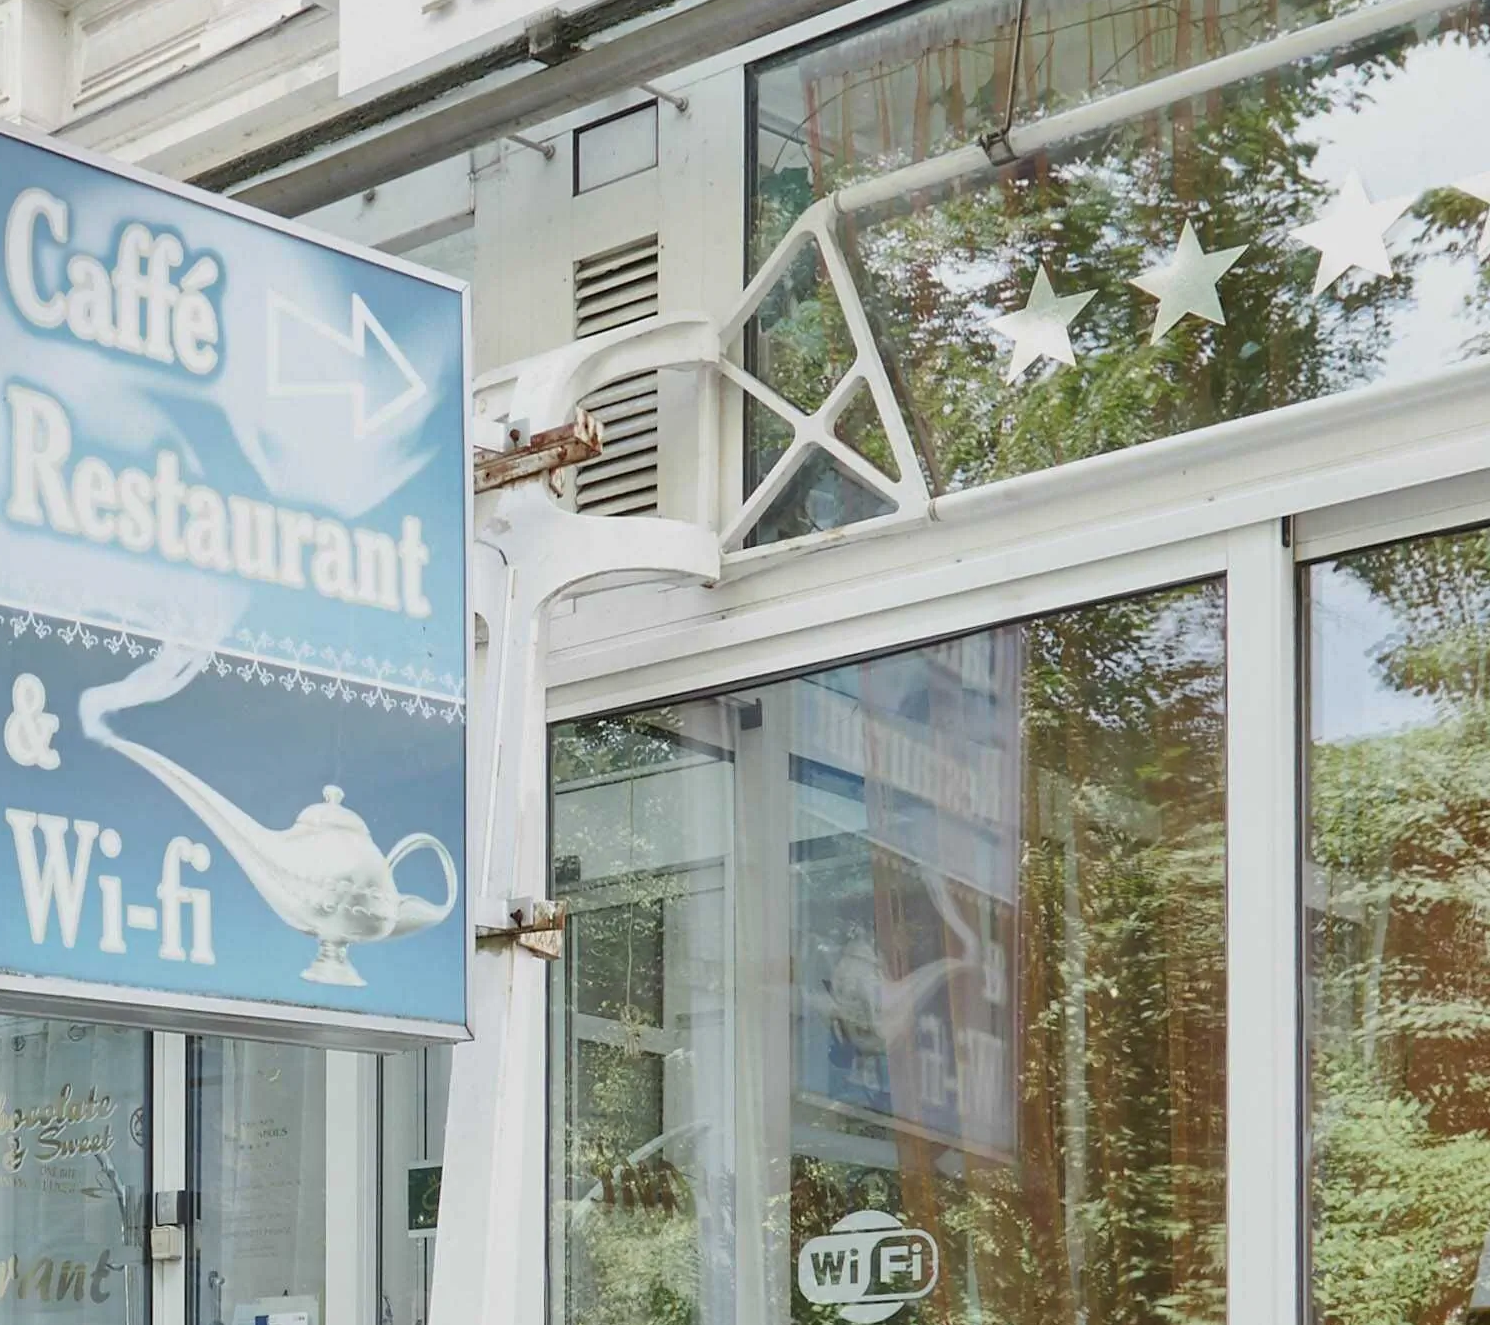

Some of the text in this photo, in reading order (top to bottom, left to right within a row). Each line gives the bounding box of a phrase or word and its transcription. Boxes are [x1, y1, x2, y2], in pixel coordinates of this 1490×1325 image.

[5, 187, 221, 377] Caffé
[5, 383, 430, 618] Restaurant
[5, 674, 60, 770] &
[5, 808, 213, 965] Wi-fi
[34, 1125, 116, 1163] Sweet
